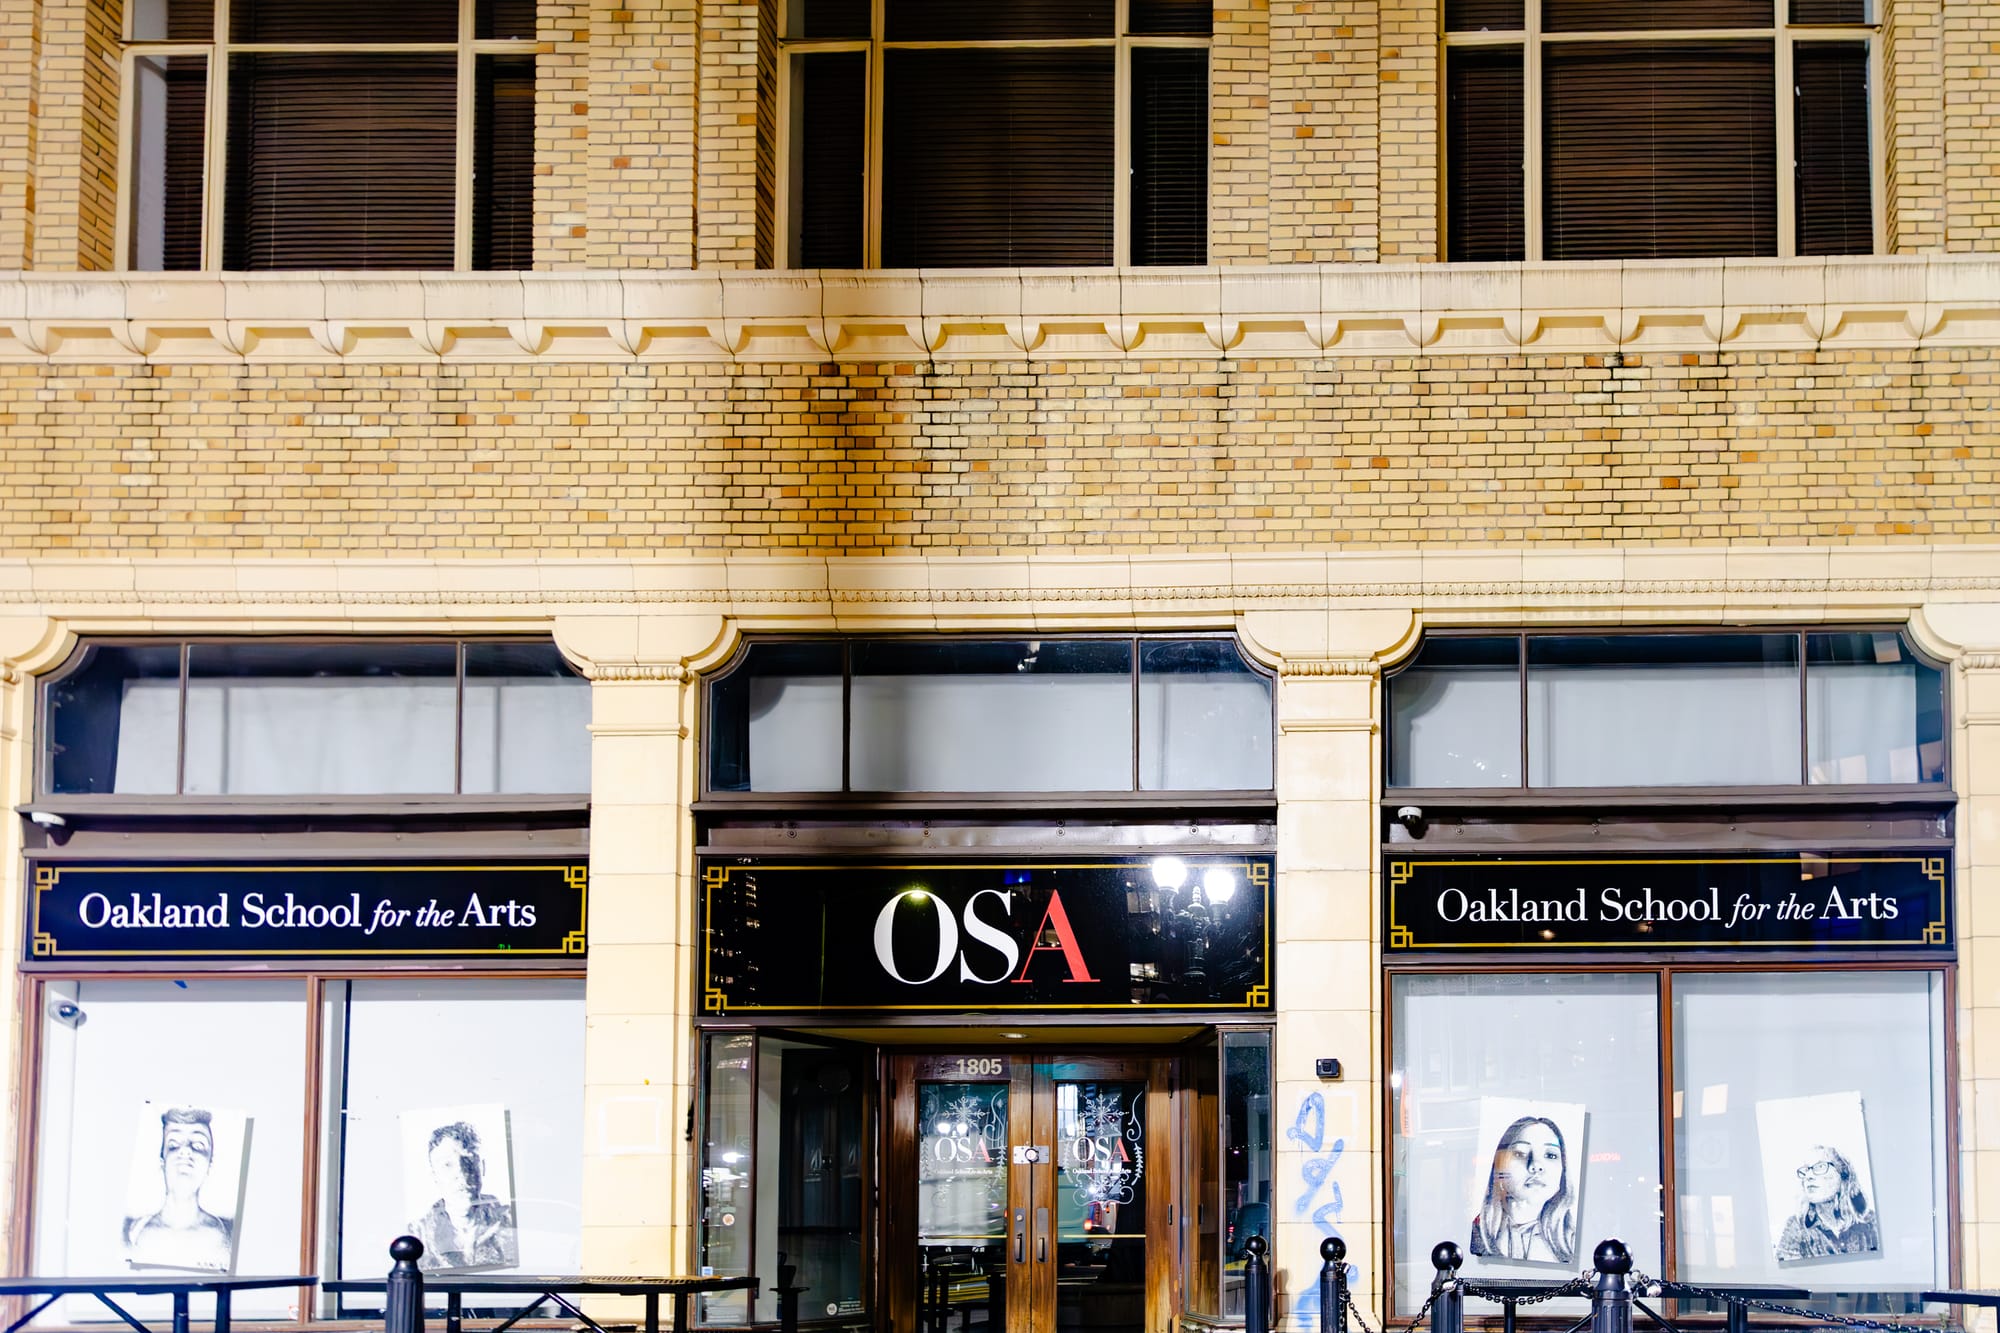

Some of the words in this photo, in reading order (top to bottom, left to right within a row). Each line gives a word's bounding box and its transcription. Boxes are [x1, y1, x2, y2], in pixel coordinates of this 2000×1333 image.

[78, 891, 230, 929] Oakland
[240, 891, 362, 929] School
[364, 898, 413, 935] for
[415, 898, 455, 928] the
[457, 891, 537, 928] Arts
[1436, 887, 1589, 923] Oakland
[1600, 886, 1722, 922] School
[1724, 892, 1772, 929] for
[1775, 892, 1816, 921] the
[1818, 884, 1899, 920] Arts
[873, 888, 1101, 985] OSA
[956, 1058, 1003, 1076] 1805
[934, 1136, 993, 1163] OSA
[1072, 1136, 1132, 1163] OSA
